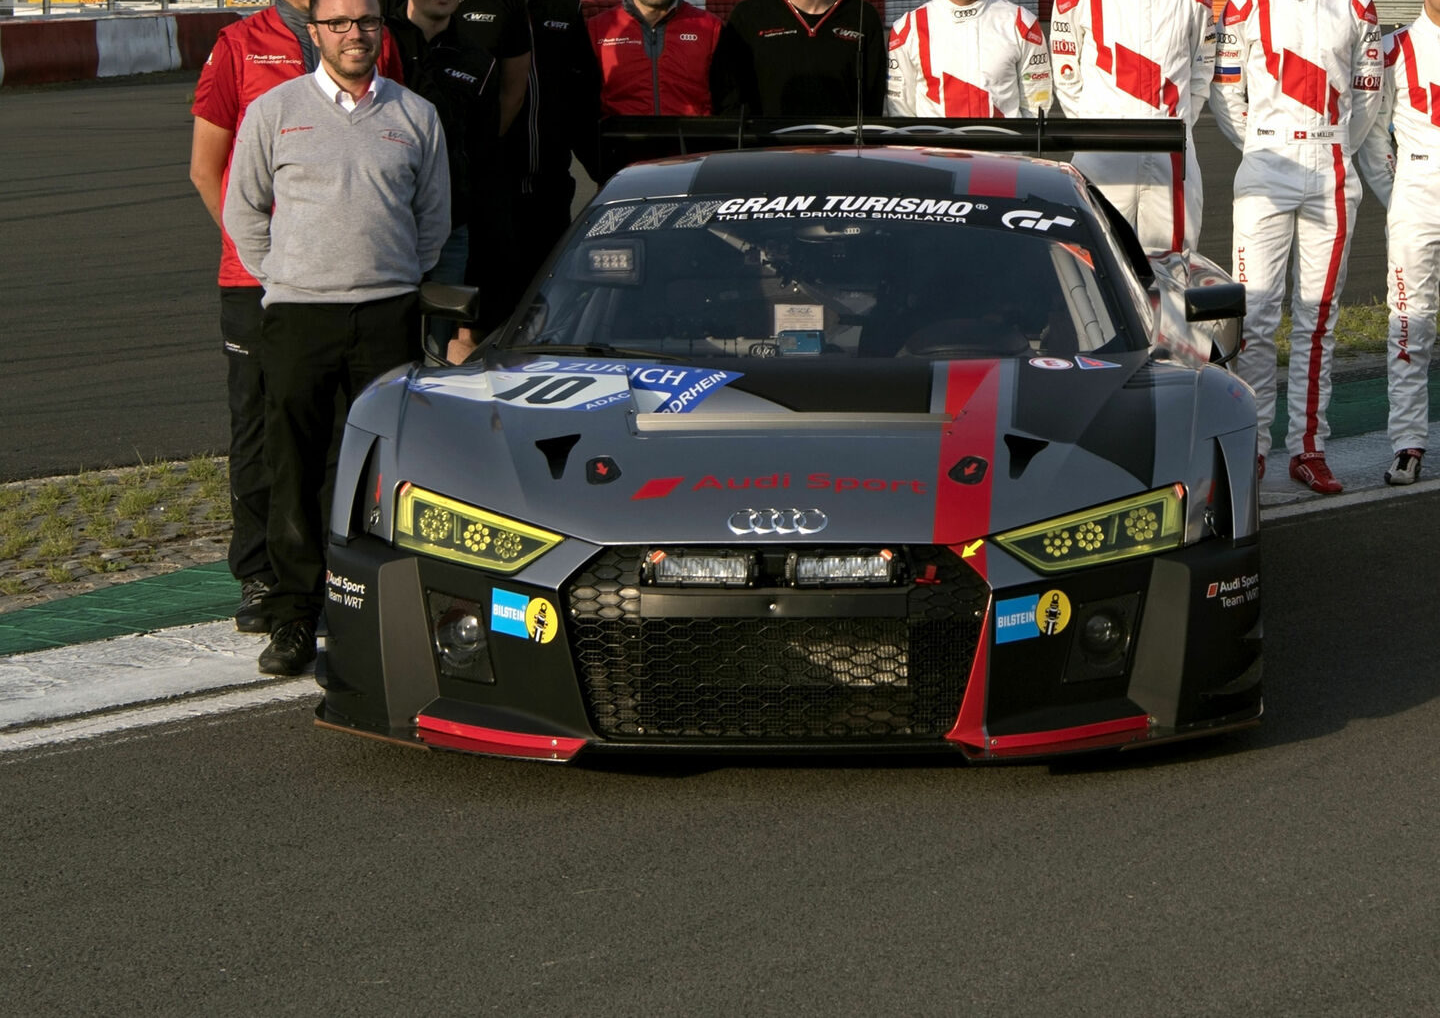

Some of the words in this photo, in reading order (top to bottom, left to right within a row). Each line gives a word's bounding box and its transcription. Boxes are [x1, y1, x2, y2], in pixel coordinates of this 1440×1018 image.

[470, 13, 496, 21] WRT
[1053, 39, 1076, 53] HÖR
[718, 195, 816, 215] GRAN
[717, 214, 742, 222] THE
[744, 213, 796, 221] REAL
[800, 211, 867, 219] DRIVING
[871, 212, 966, 223] SIMULATOR
[1238, 247, 1248, 282] port
[1395, 267, 1408, 311] Sport
[1397, 315, 1409, 349] Audi
[559, 362, 686, 386] ZURICH
[492, 375, 597, 405] 10
[585, 391, 631, 411] ADAC
[692, 473, 791, 491] Audi
[807, 473, 927, 494] Sport
[329, 572, 343, 588] Audi
[343, 578, 365, 595] Sport
[1220, 577, 1240, 592] Audi
[328, 588, 343, 603] Team
[344, 594, 364, 610] WRT
[1220, 594, 1245, 609] Team
[493, 603, 526, 622] BILSTEIN
[997, 609, 1035, 628] BILSTEIN
